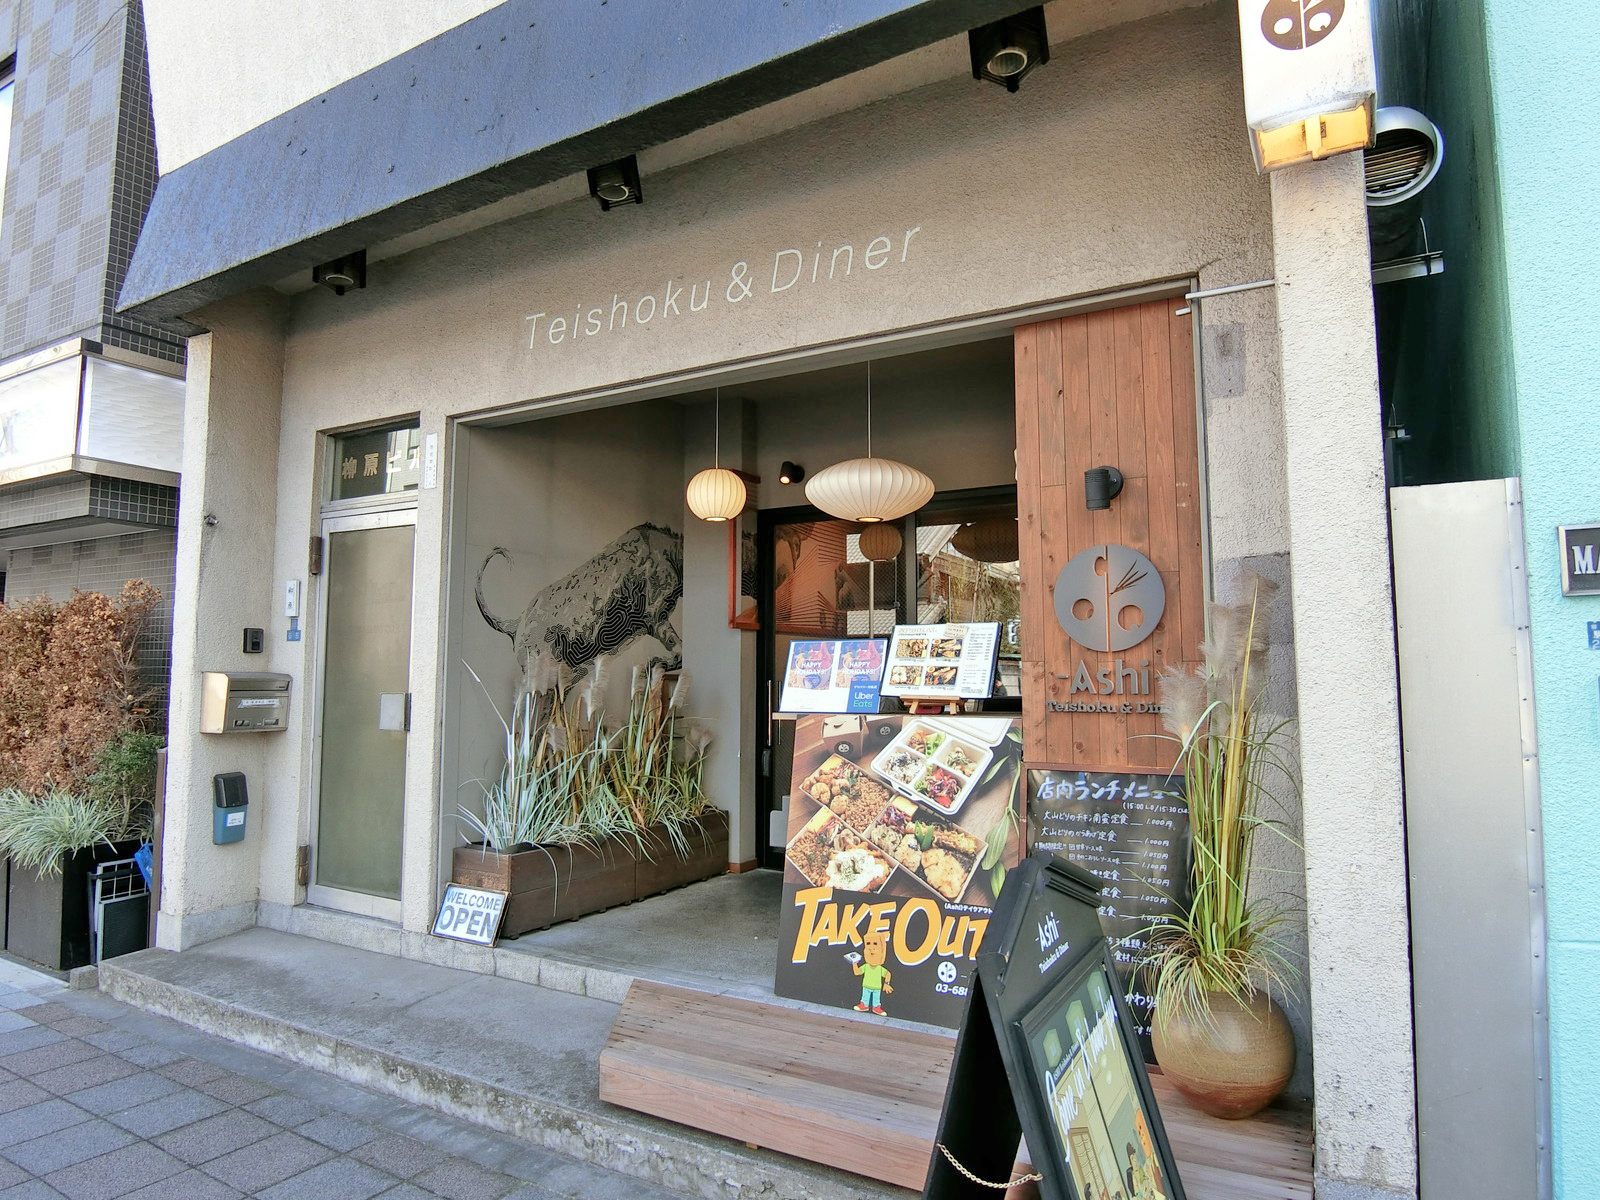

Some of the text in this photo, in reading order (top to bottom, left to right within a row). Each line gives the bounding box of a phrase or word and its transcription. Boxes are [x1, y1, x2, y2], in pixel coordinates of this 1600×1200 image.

[525, 226, 922, 350] Teishoku & Diner
[1571, 545, 1600, 575] M
[853, 700, 873, 708] Eats
[854, 692, 874, 700] Uber
[1047, 701, 1168, 714] Teishoku & Din
[1036, 776, 1180, 801] 店内ランチメニュー
[446, 890, 501, 912] WELCOME
[439, 904, 499, 939] OPEN
